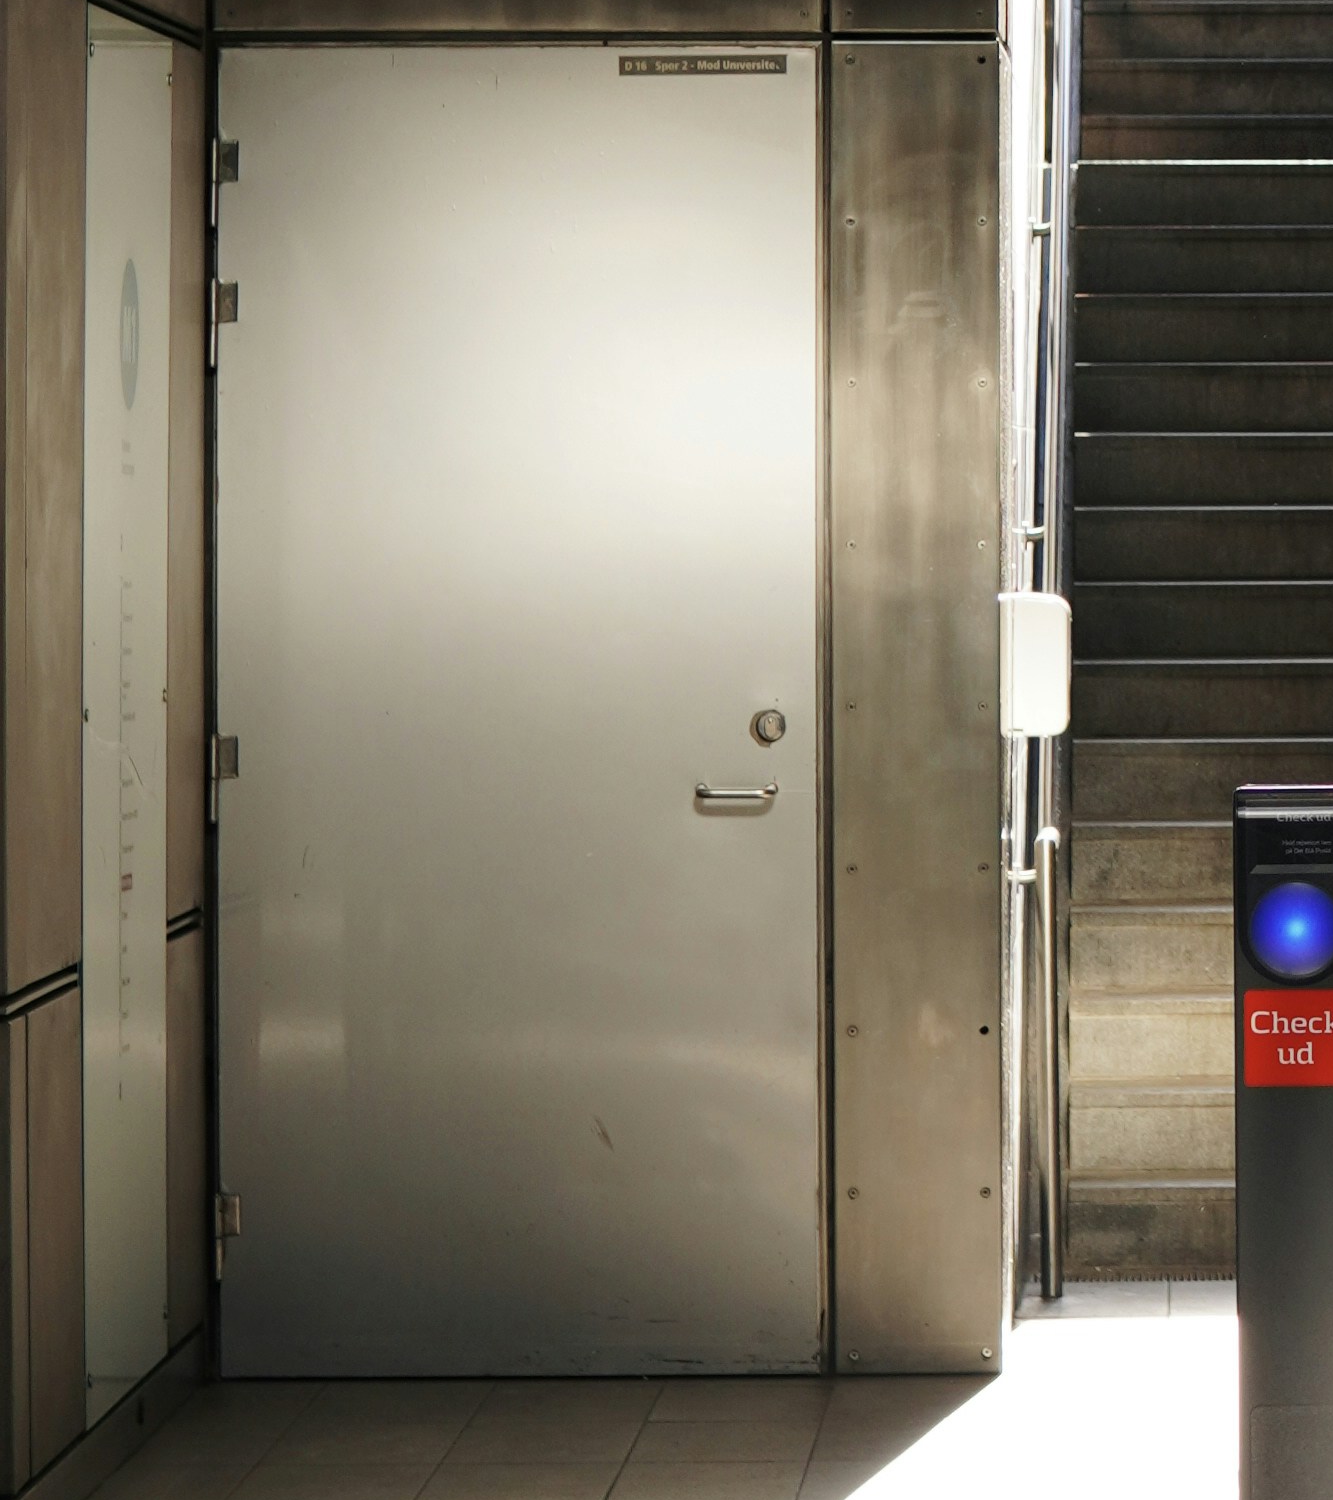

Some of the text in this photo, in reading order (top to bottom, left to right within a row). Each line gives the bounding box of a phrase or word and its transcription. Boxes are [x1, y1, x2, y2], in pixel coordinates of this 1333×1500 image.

[624, 61, 633, 72] D
[635, 61, 648, 72] 16
[655, 61, 680, 74] Spor
[681, 61, 689, 71] 2
[696, 59, 721, 71] Mod
[1277, 1042, 1315, 1066] ud
